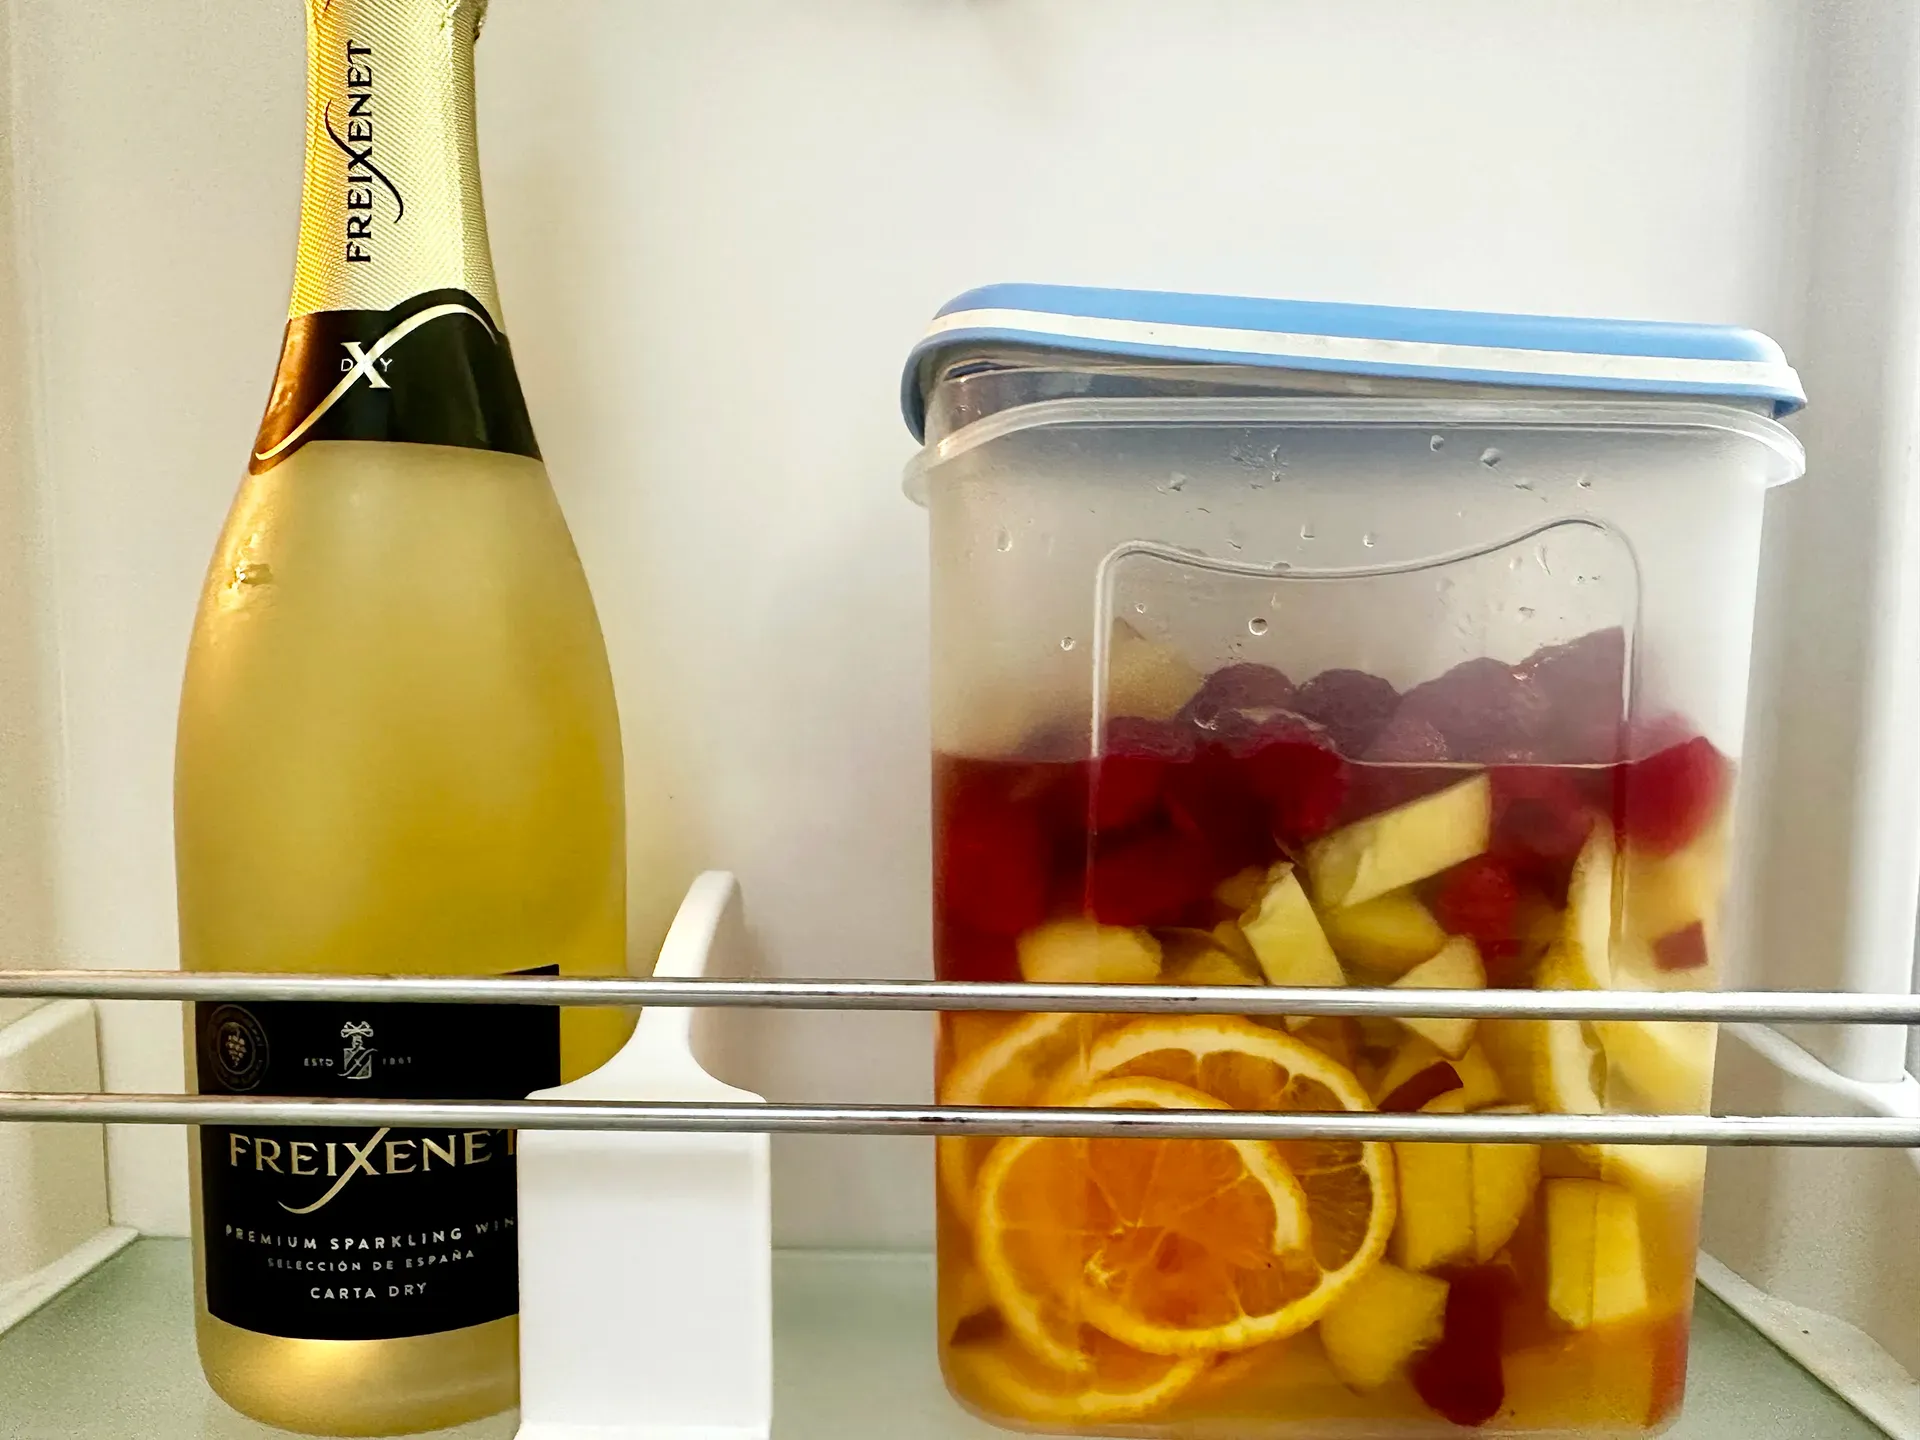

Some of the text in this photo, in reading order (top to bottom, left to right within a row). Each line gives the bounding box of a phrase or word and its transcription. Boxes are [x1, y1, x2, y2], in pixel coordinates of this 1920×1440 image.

[325, 39, 404, 262] FREIXENET
[225, 1223, 318, 1250] PREMIUM
[330, 1227, 462, 1251] SPARKLING
[267, 1249, 475, 1272] SELECCIÓN DE ESPAÑA
[310, 1282, 427, 1300] CARTA DRY
